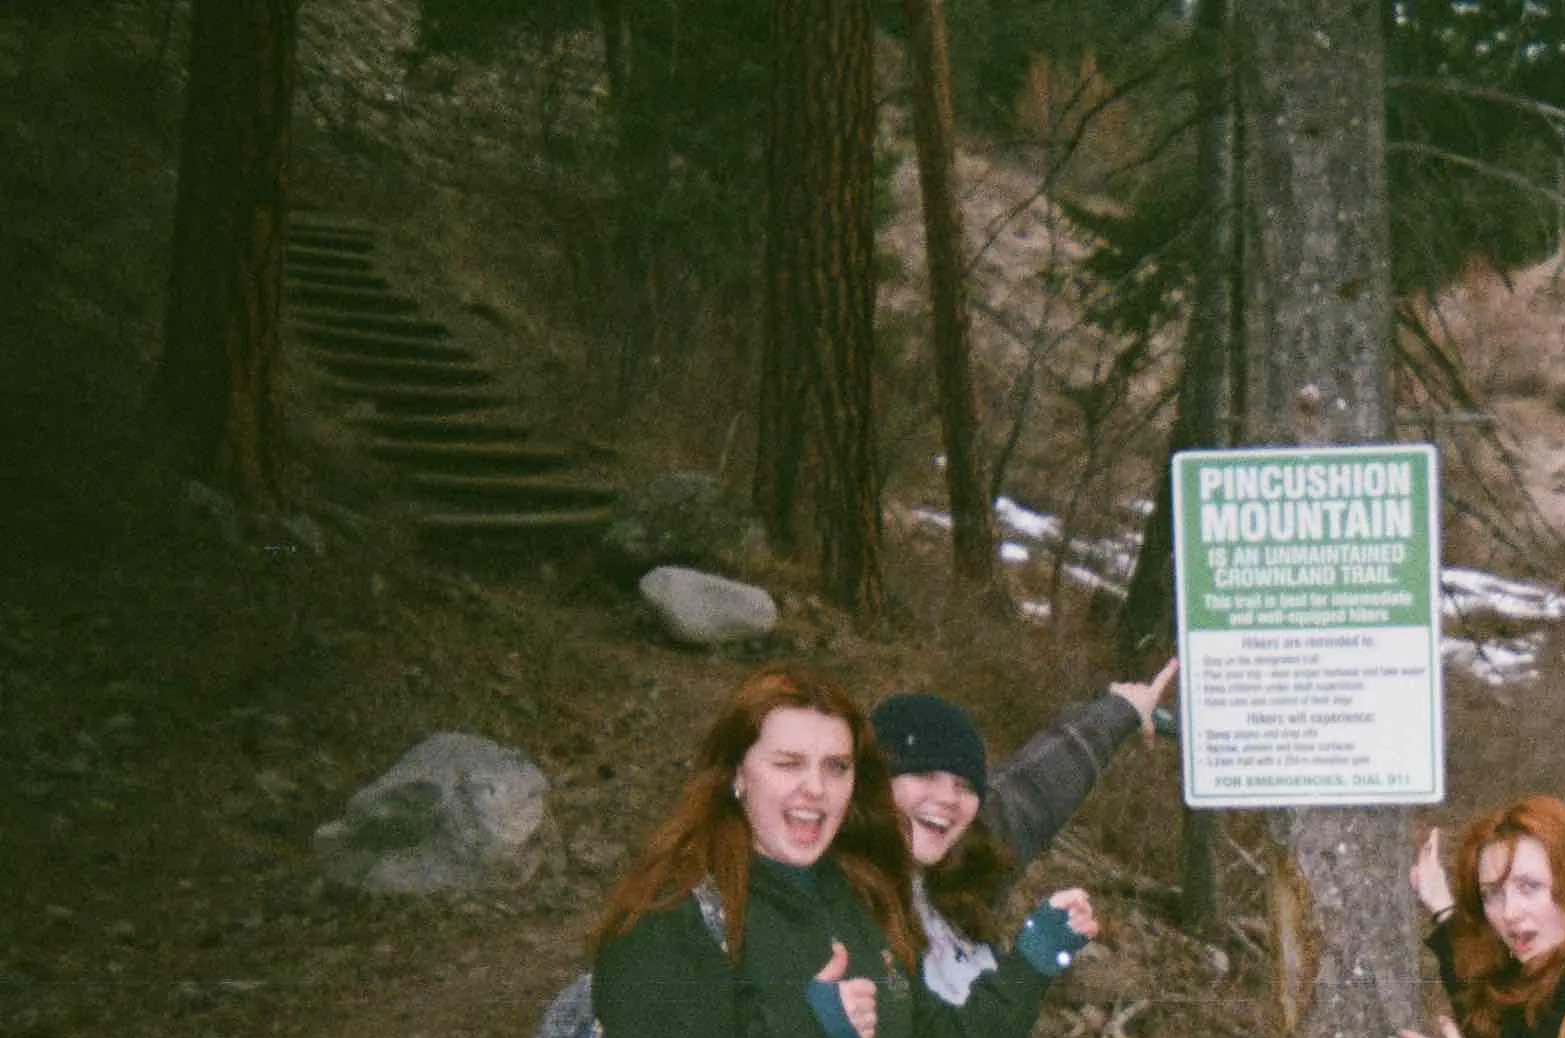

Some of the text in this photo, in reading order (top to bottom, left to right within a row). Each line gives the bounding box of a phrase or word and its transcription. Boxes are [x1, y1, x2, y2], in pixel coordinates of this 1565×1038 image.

[1200, 462, 1411, 500] PINCUSHION
[1202, 500, 1412, 541] MOUNTAIN
[1208, 544, 1405, 568] IS AN UNMAINTAINED
[1214, 567, 1336, 587] CROWNLAND
[1214, 774, 1242, 788] FOR
[1352, 773, 1383, 786] DIAL
[1386, 772, 1411, 785] 911
